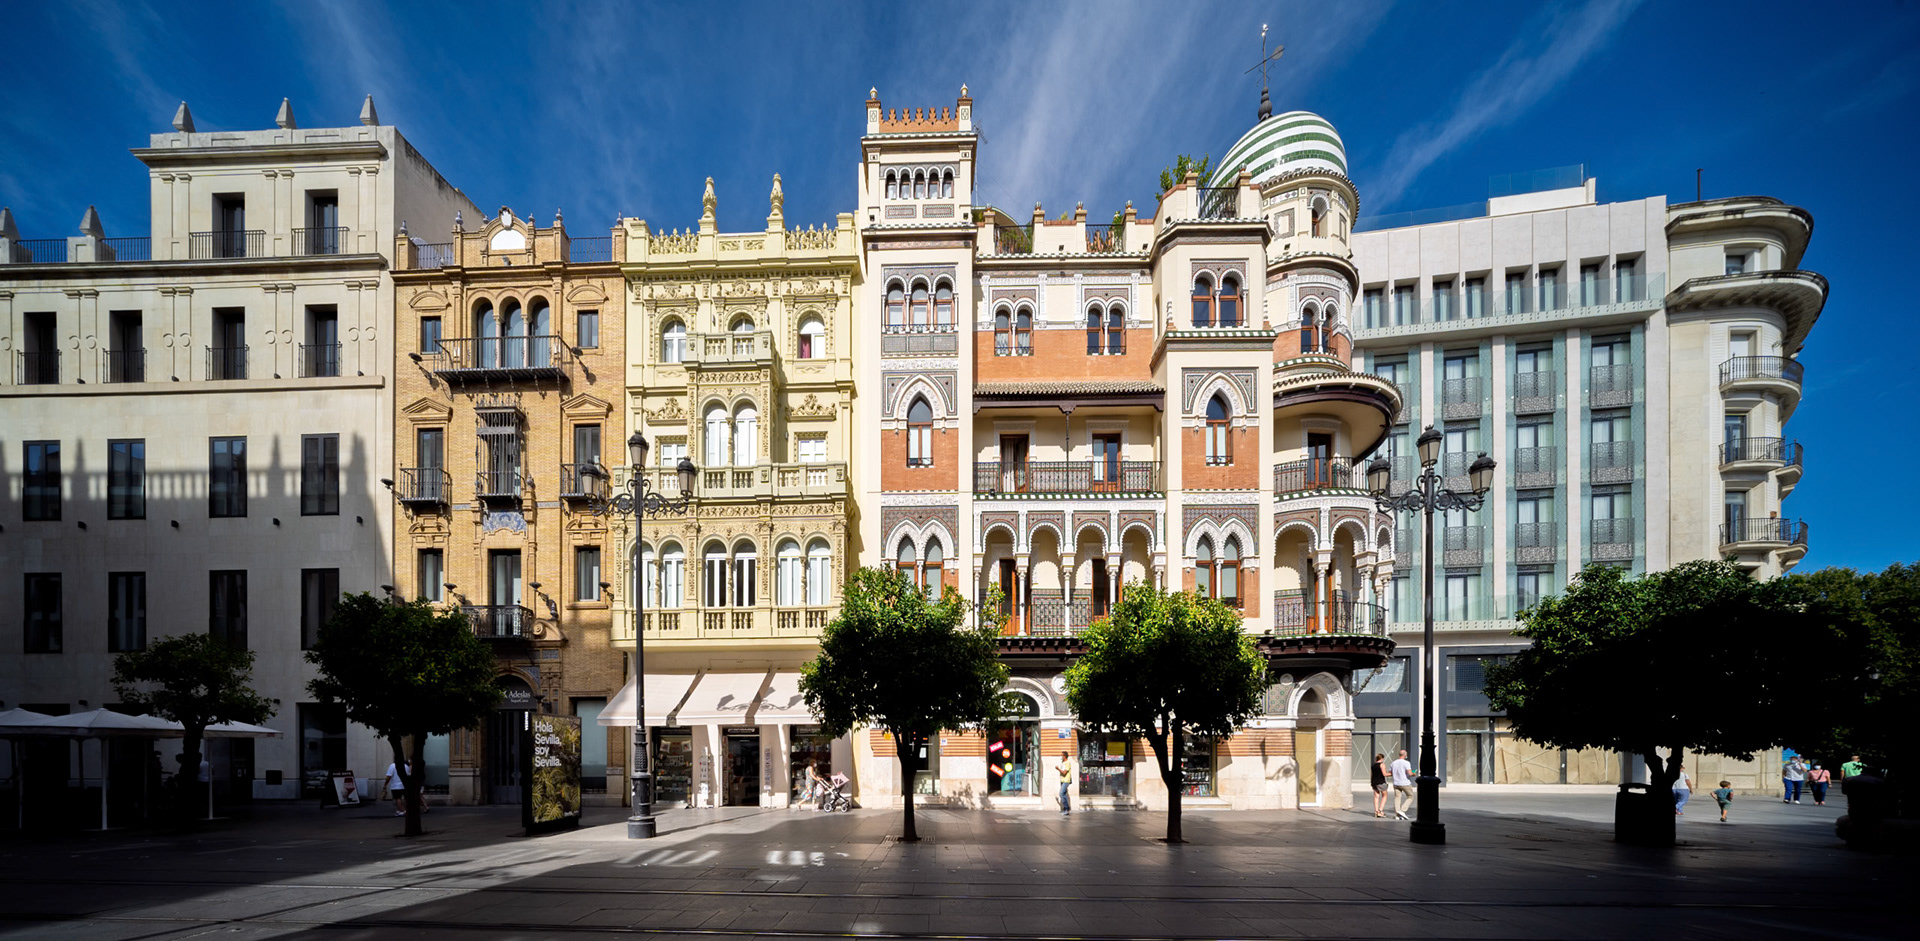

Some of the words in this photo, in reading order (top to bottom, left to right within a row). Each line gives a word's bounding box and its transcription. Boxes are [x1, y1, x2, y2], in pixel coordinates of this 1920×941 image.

[508, 690, 531, 698] Adeslas
[535, 721, 553, 732] Hola
[535, 733, 562, 746] Sevilla,
[535, 747, 549, 757] soy
[535, 756, 562, 767] Sevilla.
